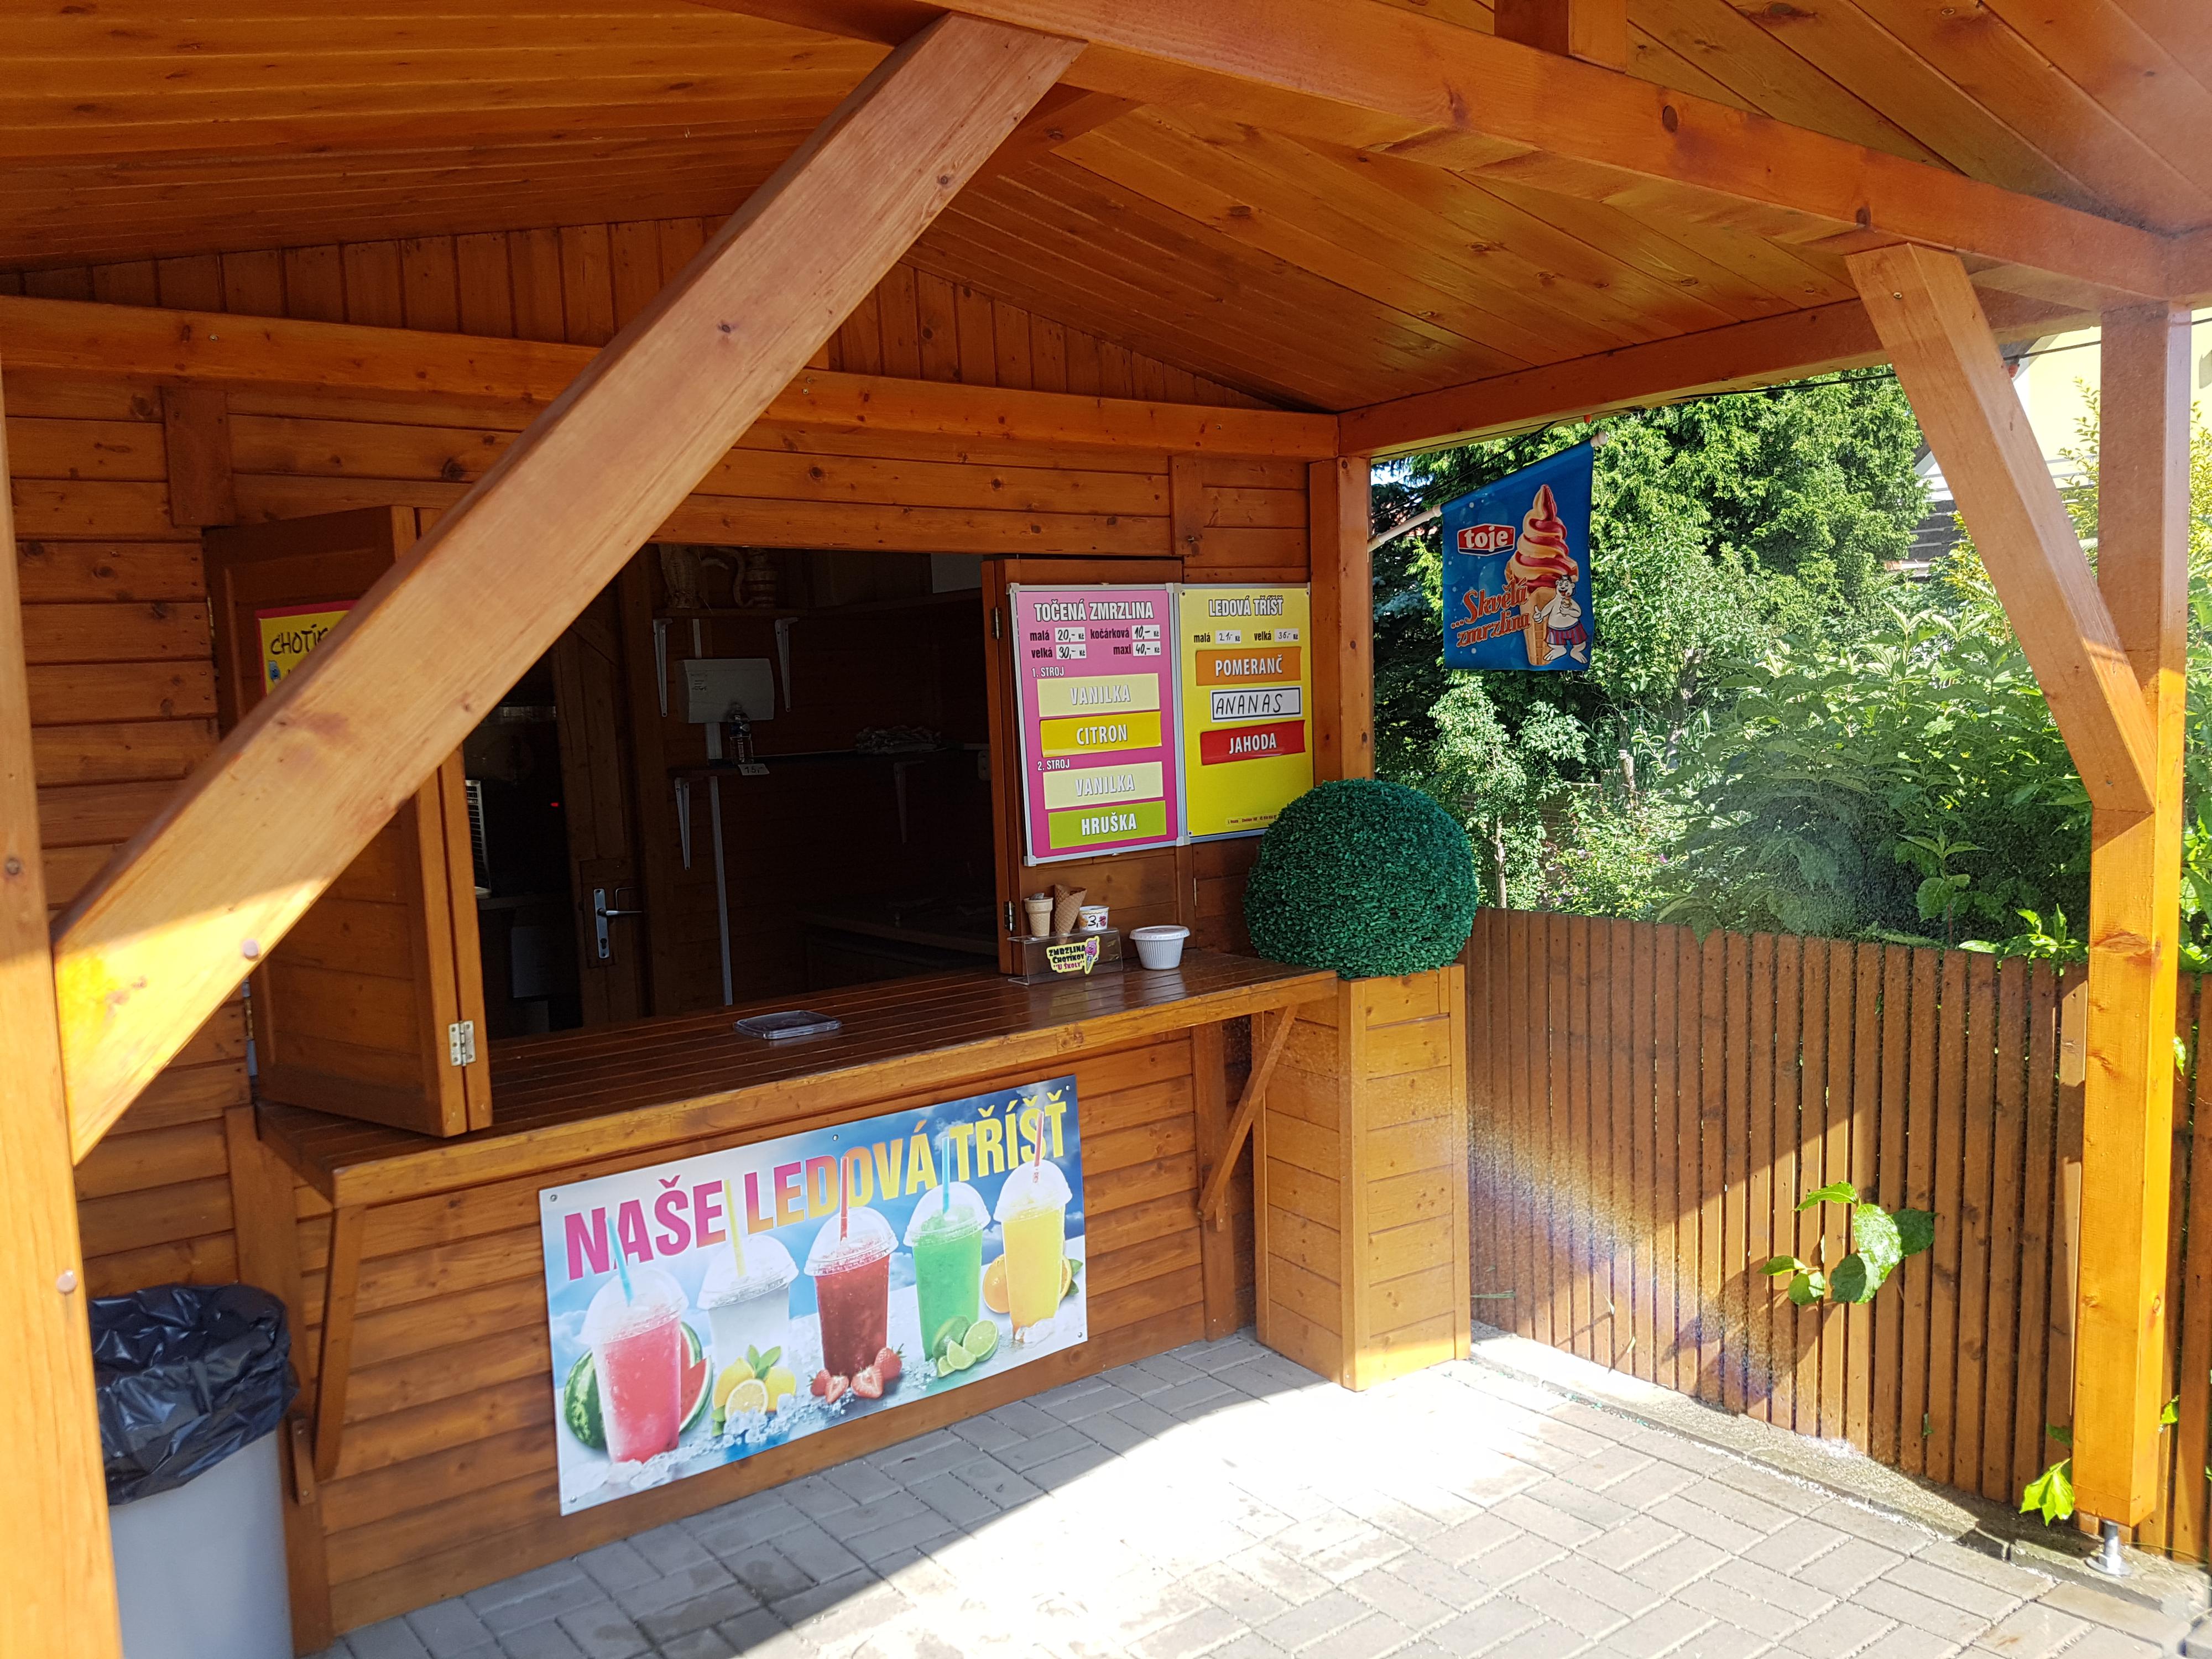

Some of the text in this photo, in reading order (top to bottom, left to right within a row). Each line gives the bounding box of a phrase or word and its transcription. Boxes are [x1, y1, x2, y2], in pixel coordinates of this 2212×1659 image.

[1464, 526, 1508, 552] toje
[1034, 599, 1154, 622] TOČENÁ ZMRZLINA
[1209, 596, 1284, 617] LEDOVÁ TŘÍŠŤ
[1030, 630, 1050, 641] malá
[1058, 629, 1076, 642] 20,-
[1091, 628, 1130, 640] kočárková
[1134, 625, 1151, 640] 10,-
[1194, 633, 1211, 643] malá
[1254, 630, 1271, 641] velká
[1456, 610, 1531, 648] zmrzlina
[1031, 648, 1052, 658] velká
[1059, 646, 1076, 659] 30,-
[1113, 644, 1131, 655] maxi
[1135, 644, 1151, 655] 40,-
[1032, 666, 1065, 677] 1. STROJ
[1215, 654, 1283, 677] POMERANČ
[1070, 684, 1131, 706] VANILKA
[1215, 693, 1283, 715] ANANAS
[1076, 724, 1128, 746] CITRON
[1229, 733, 1276, 755] JAHODA
[1037, 759, 1070, 771] 2. STROJ
[1075, 774, 1135, 797] VANILKA
[1081, 811, 1137, 836] HRUŠKA
[1048, 945, 1086, 956] ZMRZLINA
[564, 1089, 1068, 1280] NAŠE LEDOVÁ TŘÍŠŤ
